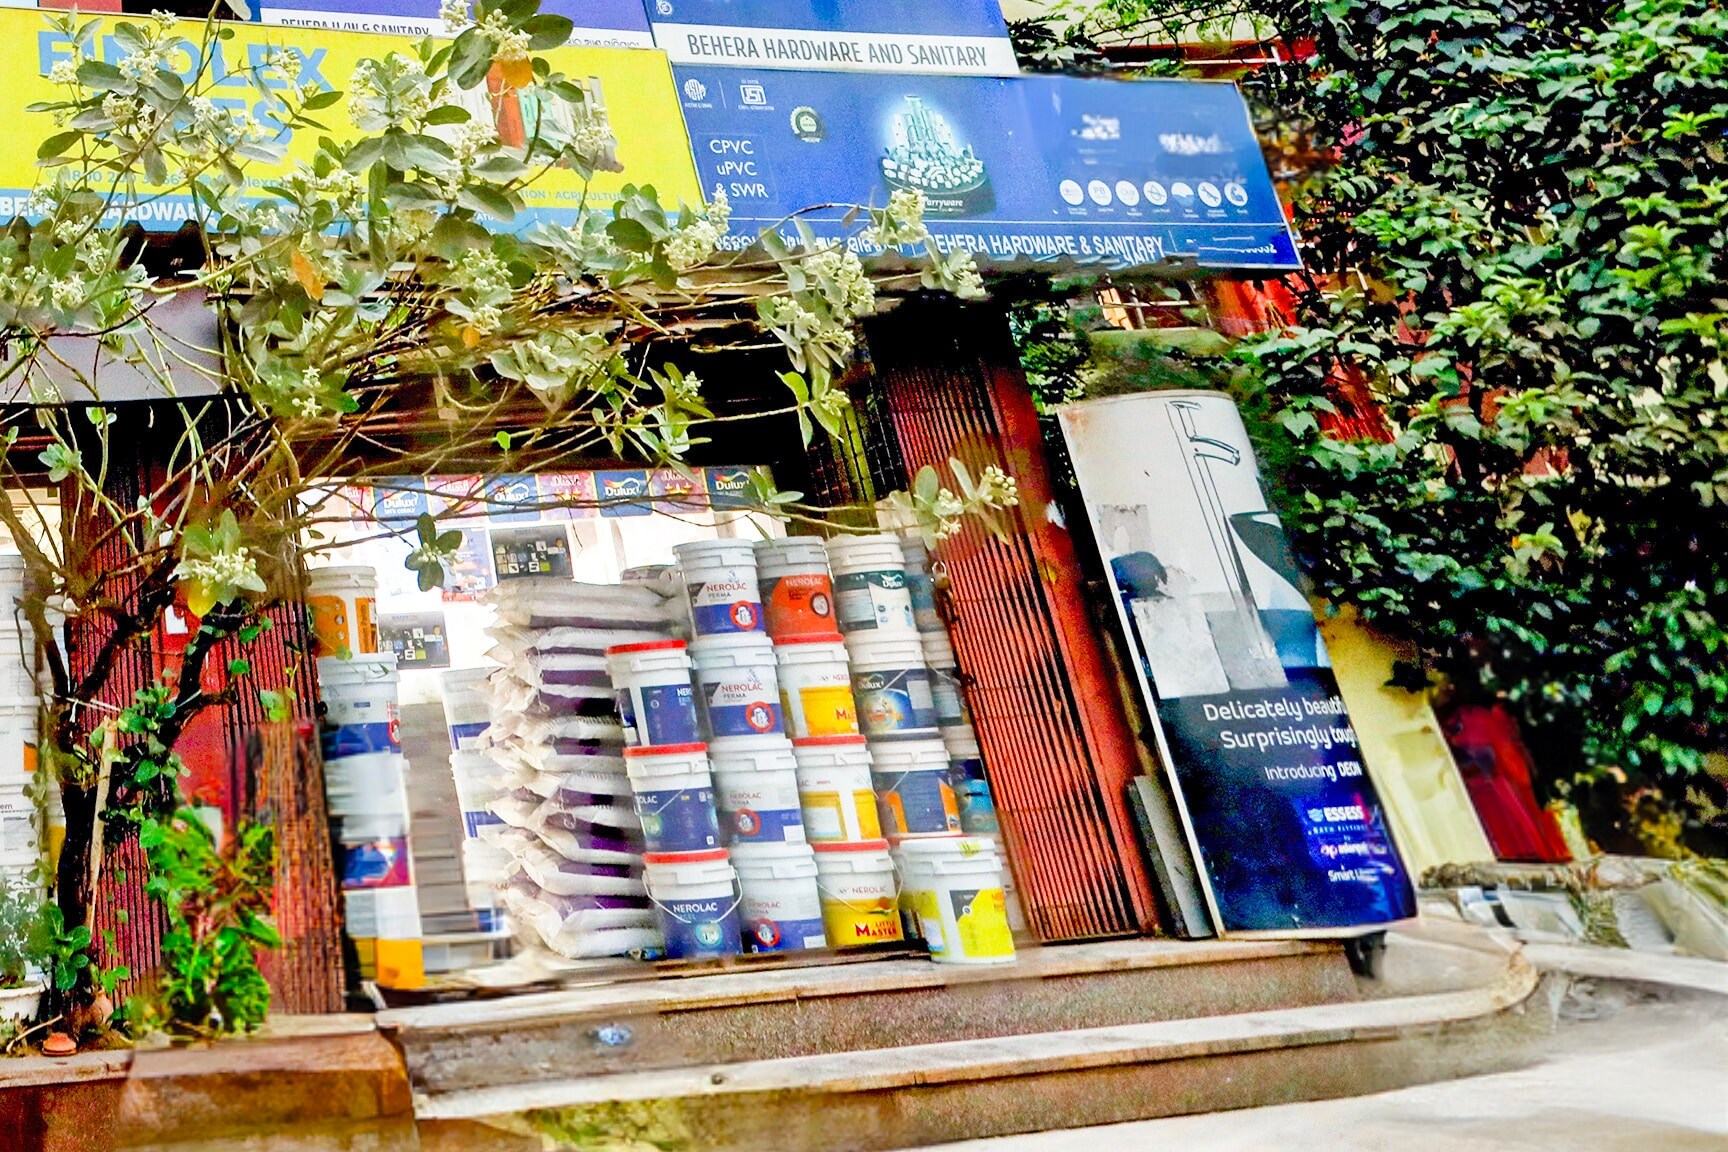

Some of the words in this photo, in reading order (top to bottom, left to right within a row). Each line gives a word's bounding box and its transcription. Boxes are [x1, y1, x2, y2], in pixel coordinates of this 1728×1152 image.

[687, 34, 760, 59] BEHERA
[763, 38, 863, 63] HARDWARE
[869, 43, 903, 64] AND
[907, 44, 988, 66] SANITARY
[709, 139, 754, 155] CPVC
[716, 161, 757, 176] uPVC
[555, 190, 630, 202] AGRICULTUR
[731, 183, 769, 198] SWR
[989, 234, 1076, 255] HARDWARE
[1080, 236, 1092, 254] &
[1093, 235, 1164, 257] SANITARY
[605, 486, 637, 498] Dulux
[383, 497, 415, 509] Dulux
[706, 582, 747, 592] NEROLAC
[722, 682, 763, 692] NEROLAC
[1203, 698, 1303, 721] Delicately
[1220, 724, 1332, 752] Surprisingly
[1265, 762, 1337, 782] Introducing
[672, 902, 718, 913] NEROLAC
